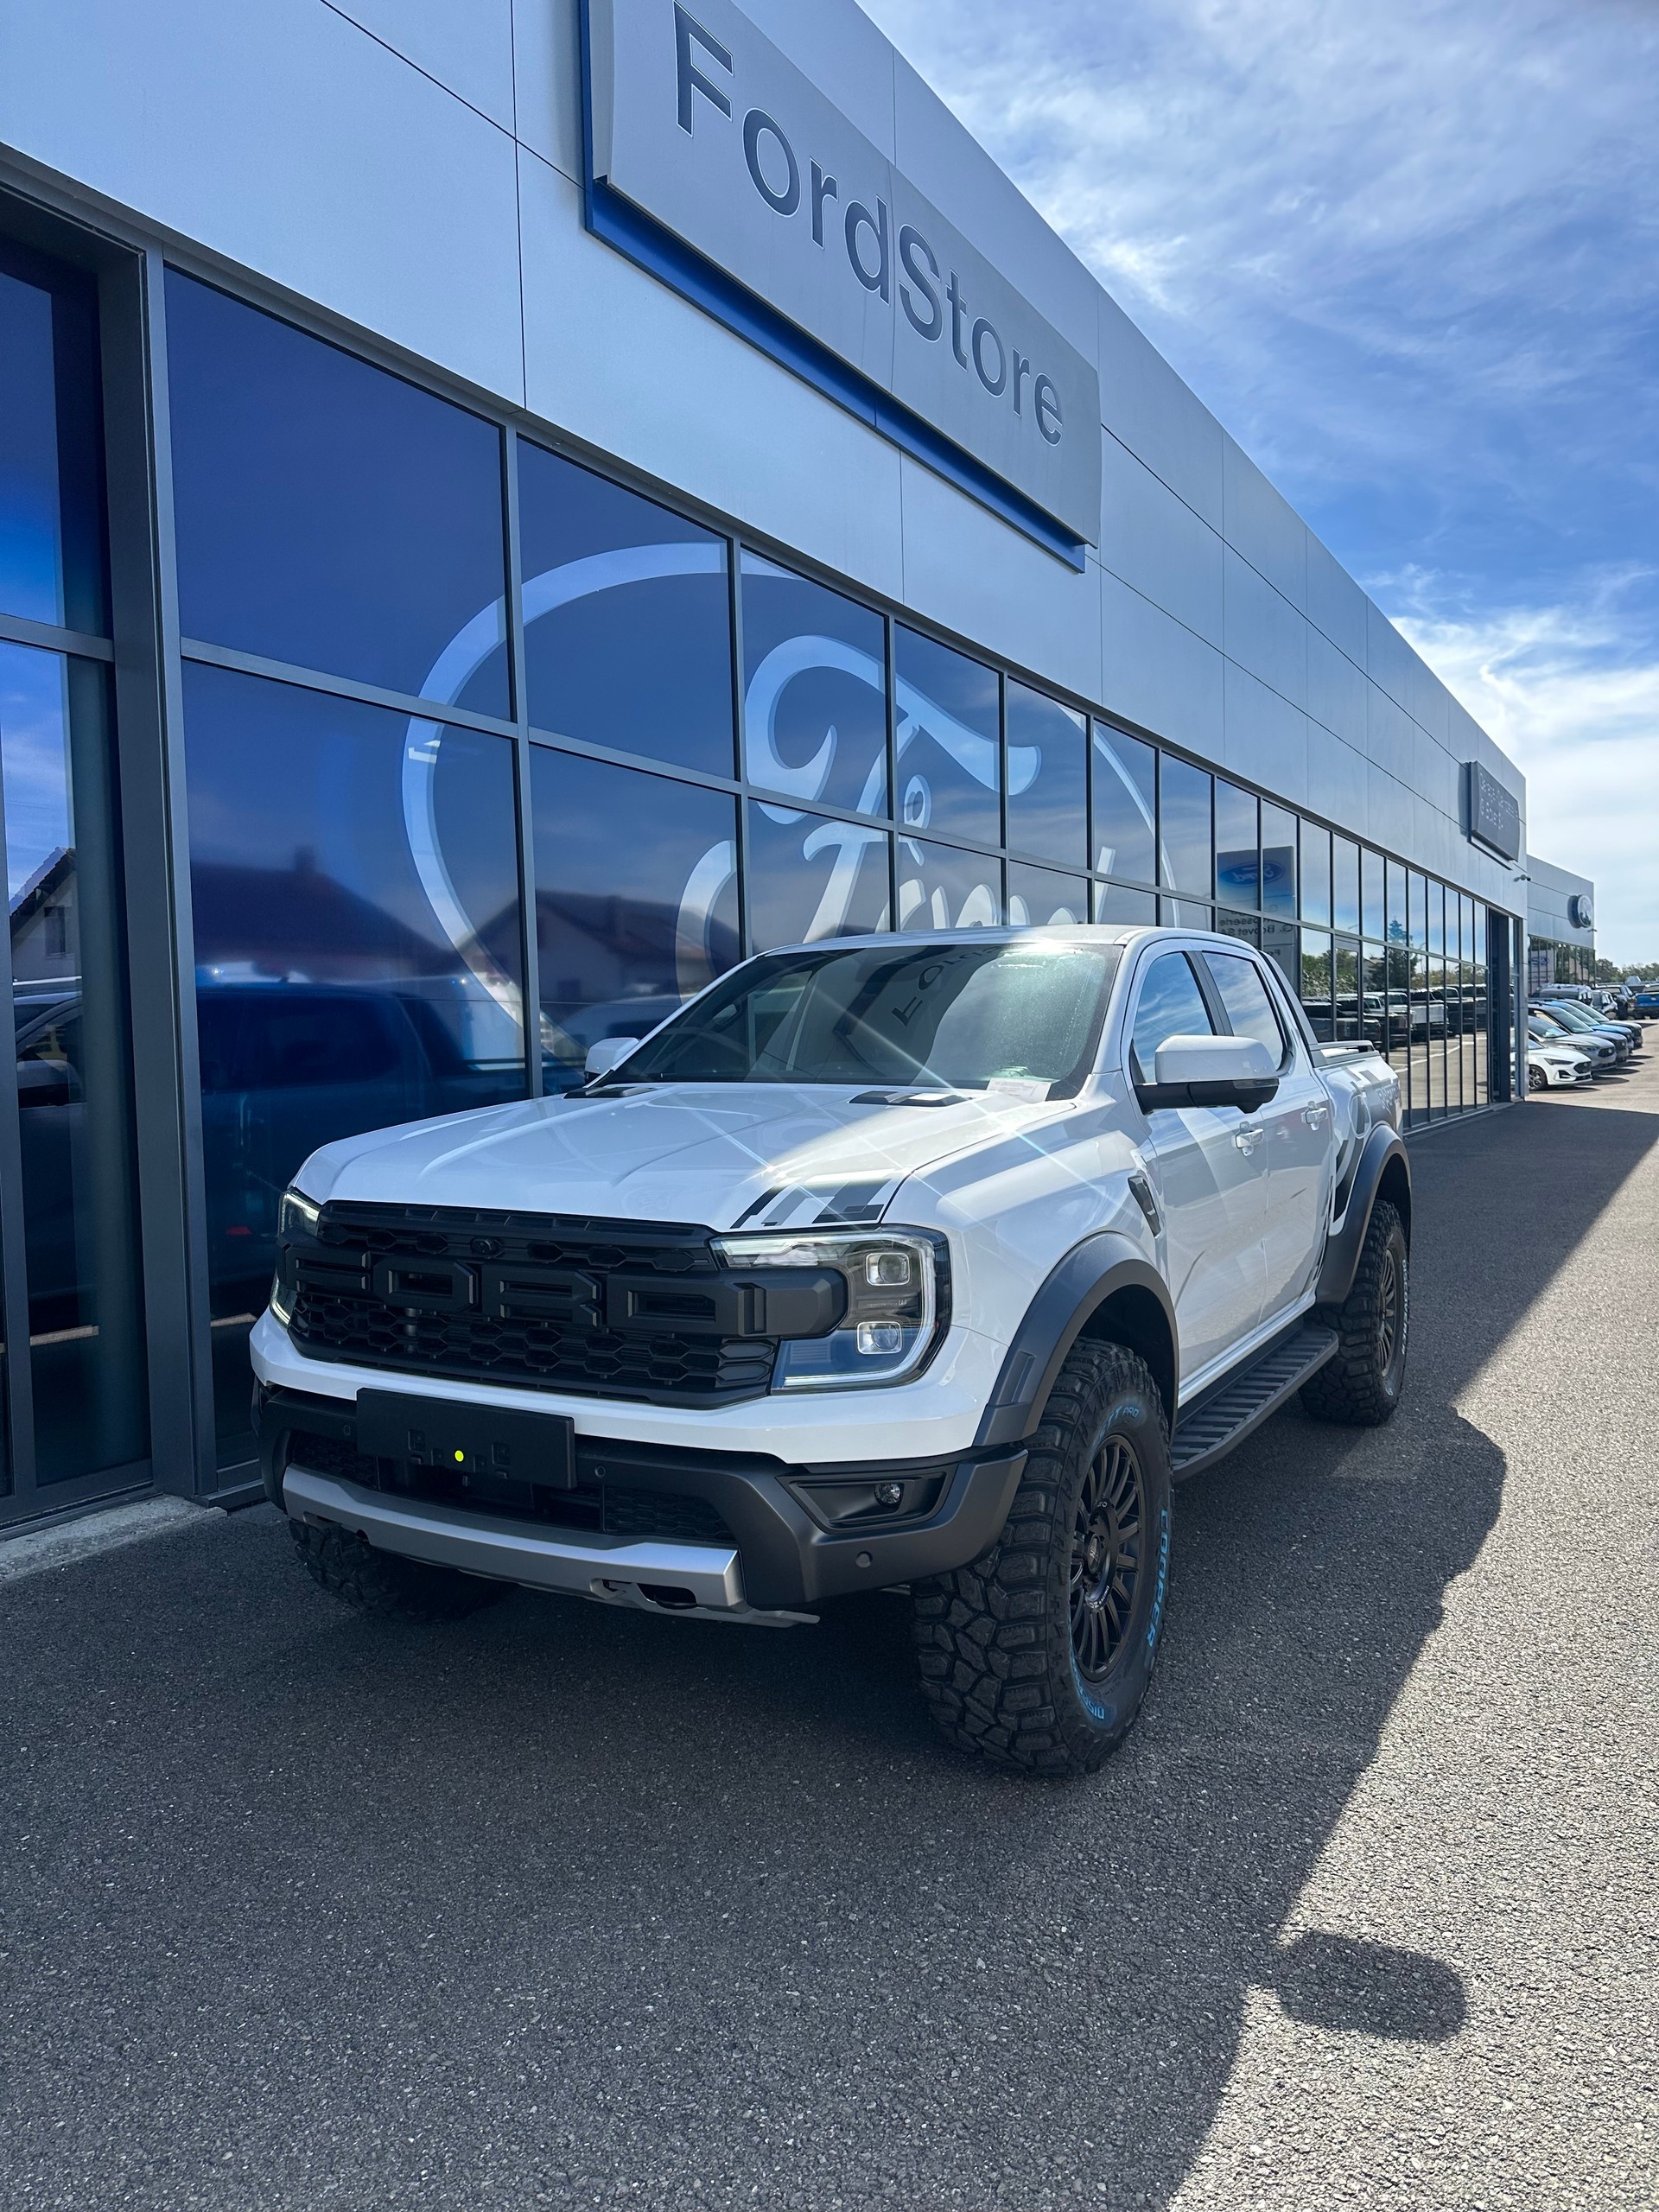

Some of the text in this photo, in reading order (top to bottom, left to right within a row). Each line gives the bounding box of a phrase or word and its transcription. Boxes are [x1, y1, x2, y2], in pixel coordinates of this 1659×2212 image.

[673, 0, 1064, 447] FordStore
[283, 1245, 765, 1337] FORD
[1122, 1406, 1140, 1418] PRO
[1147, 1510, 1170, 1647] COOPER
